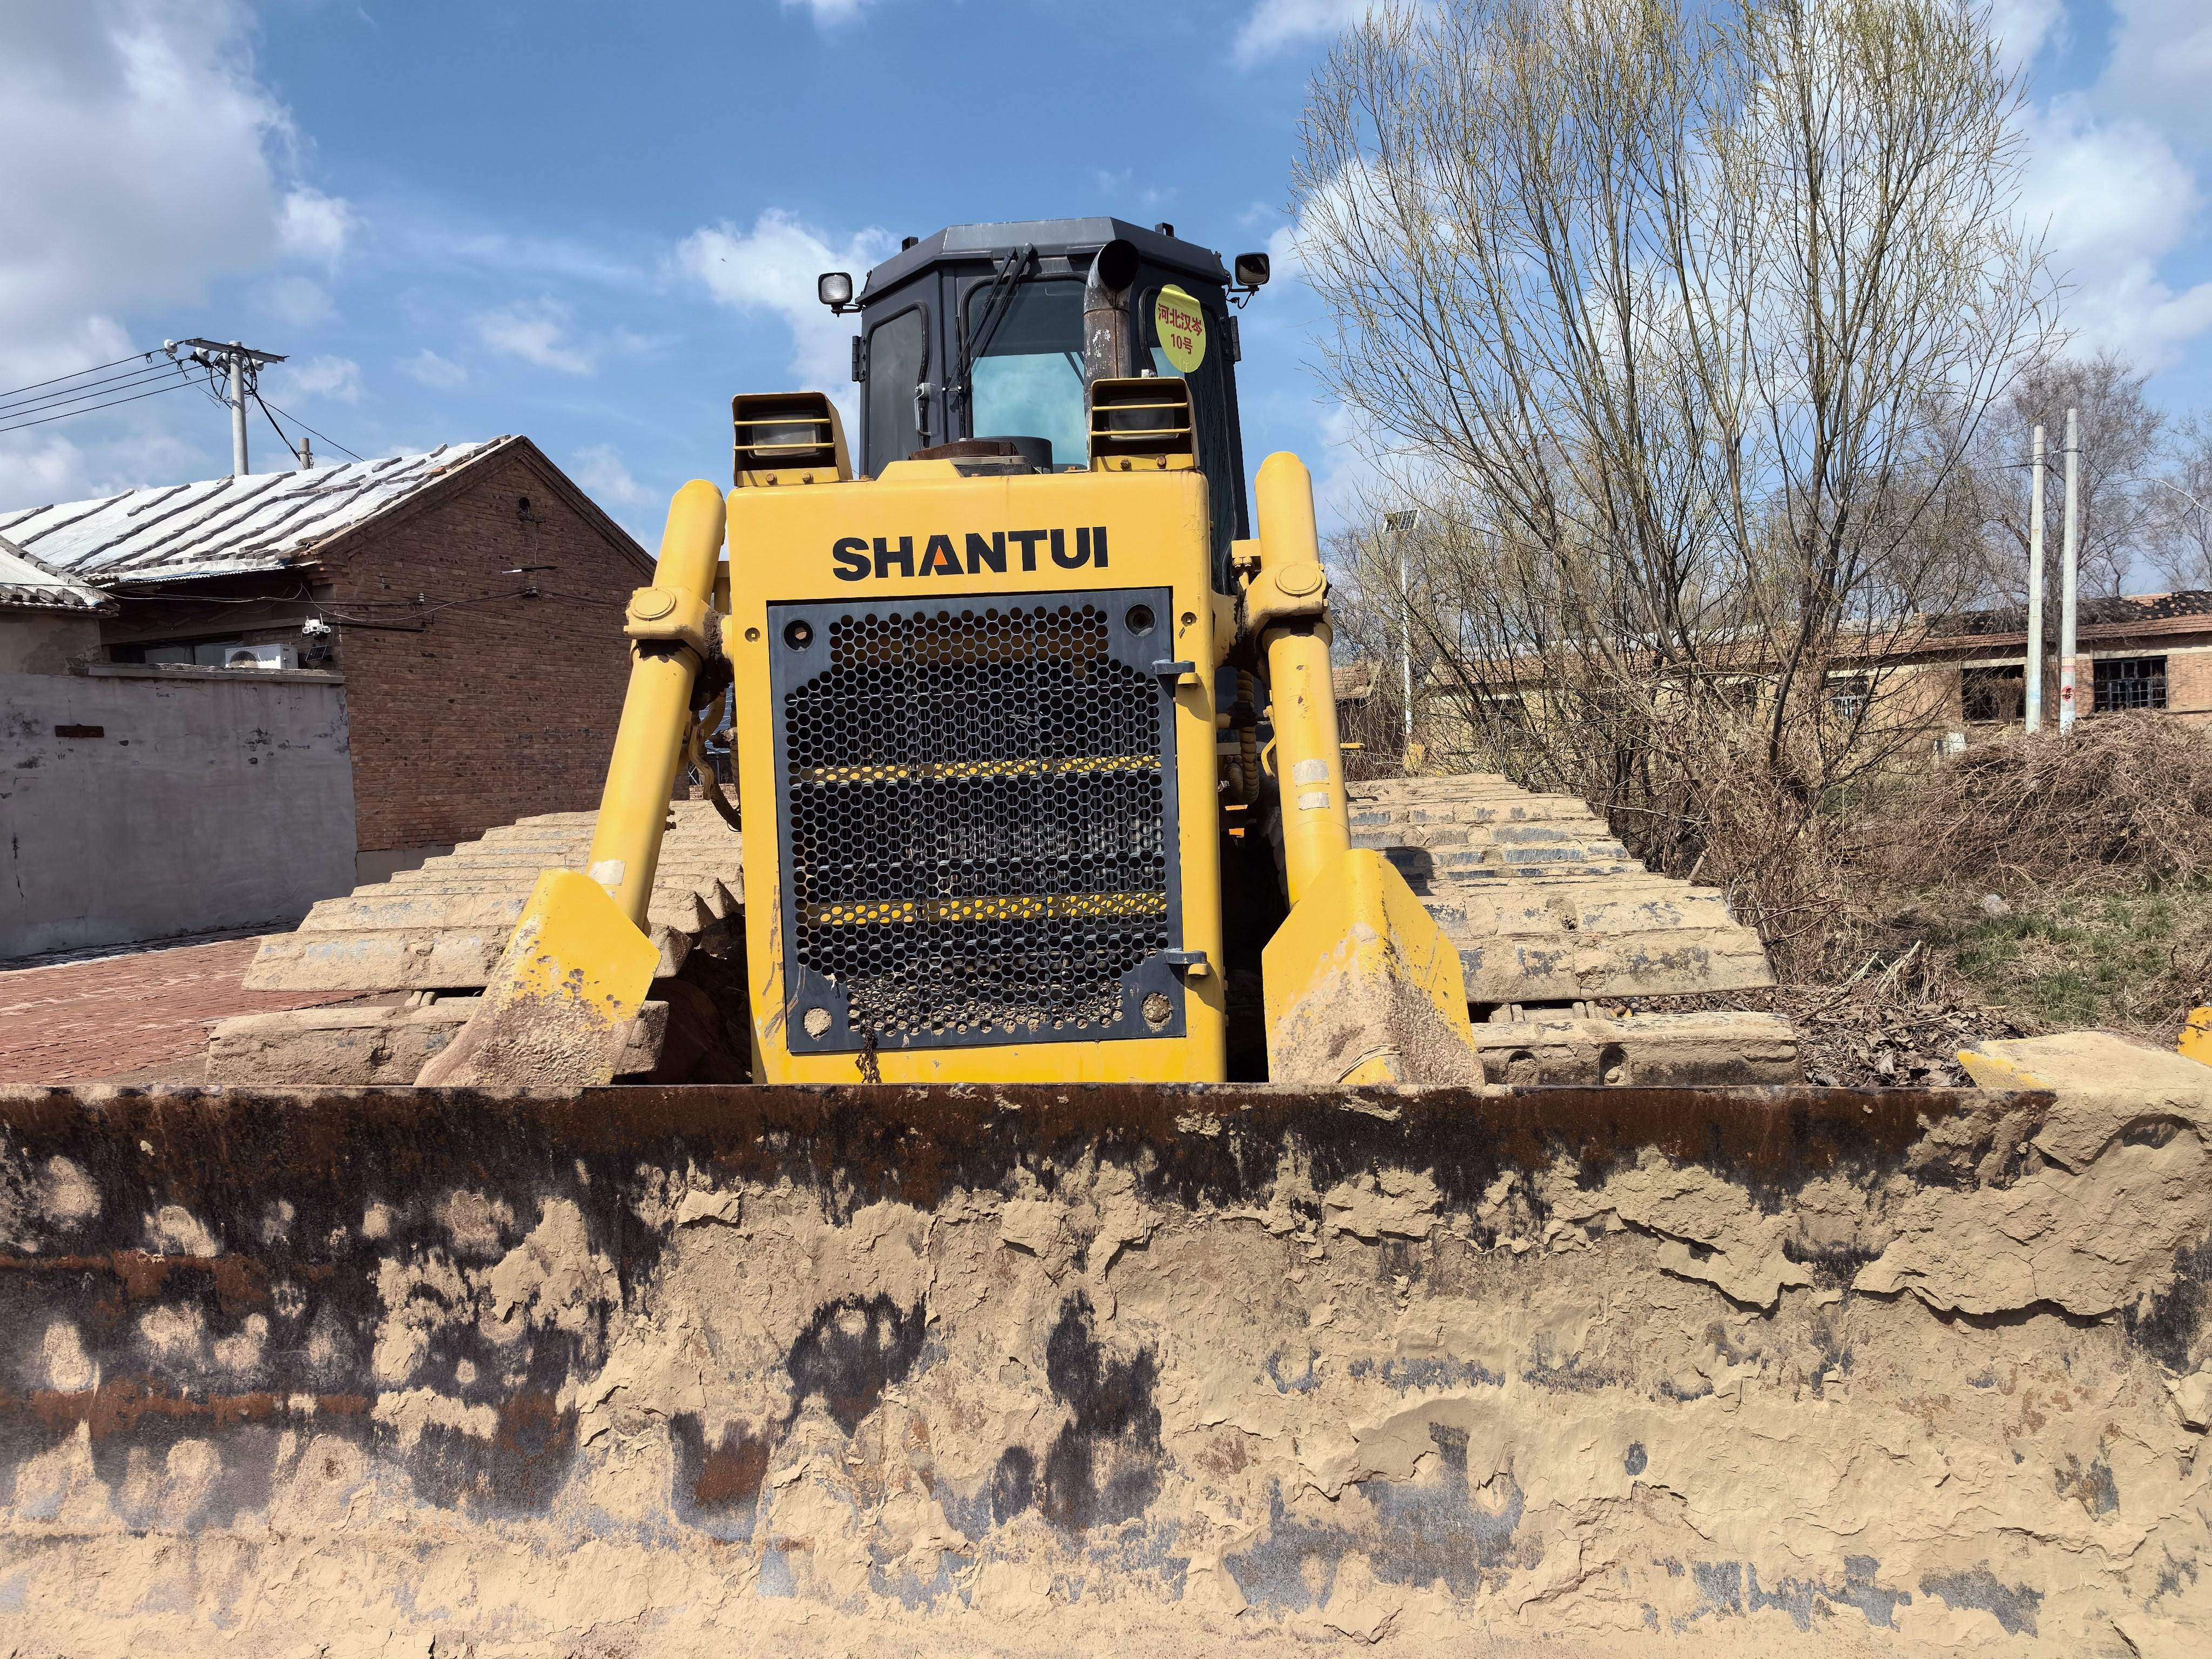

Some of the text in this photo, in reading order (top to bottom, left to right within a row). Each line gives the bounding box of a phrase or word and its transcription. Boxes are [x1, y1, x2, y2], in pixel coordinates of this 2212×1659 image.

[1158, 303, 1202, 336] 河北汉岑
[1171, 333, 1192, 355] 10号
[832, 526, 1109, 582] SHANTUI
